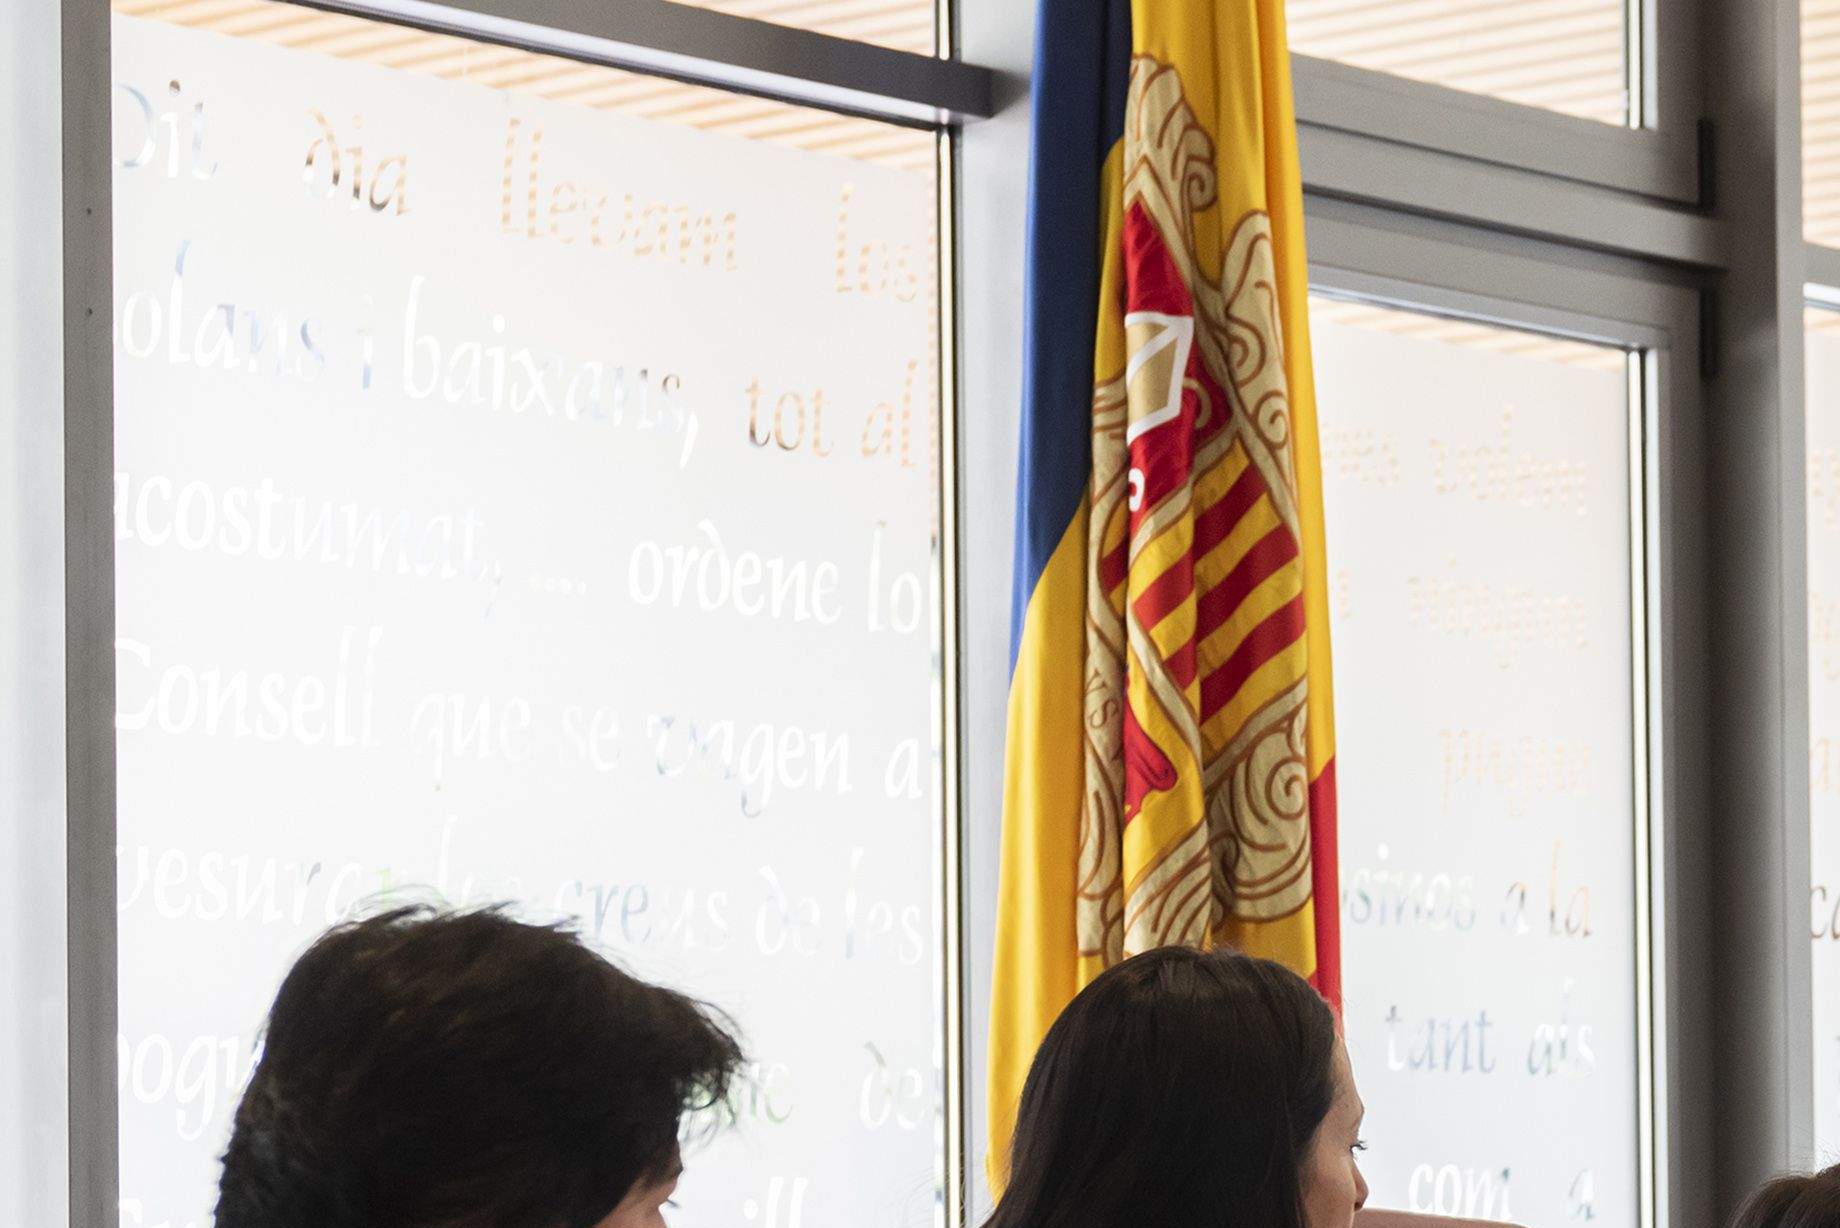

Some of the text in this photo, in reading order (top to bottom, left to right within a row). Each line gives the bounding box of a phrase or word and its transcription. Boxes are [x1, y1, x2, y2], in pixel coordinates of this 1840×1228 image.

[305, 107, 413, 217] dia
[117, 239, 326, 383] olans
[744, 375, 835, 458] tot
[859, 358, 919, 468] al
[115, 625, 383, 749] Consell
[411, 690, 533, 792] que
[884, 737, 923, 800] a
[1384, 1004, 1496, 1076] tant
